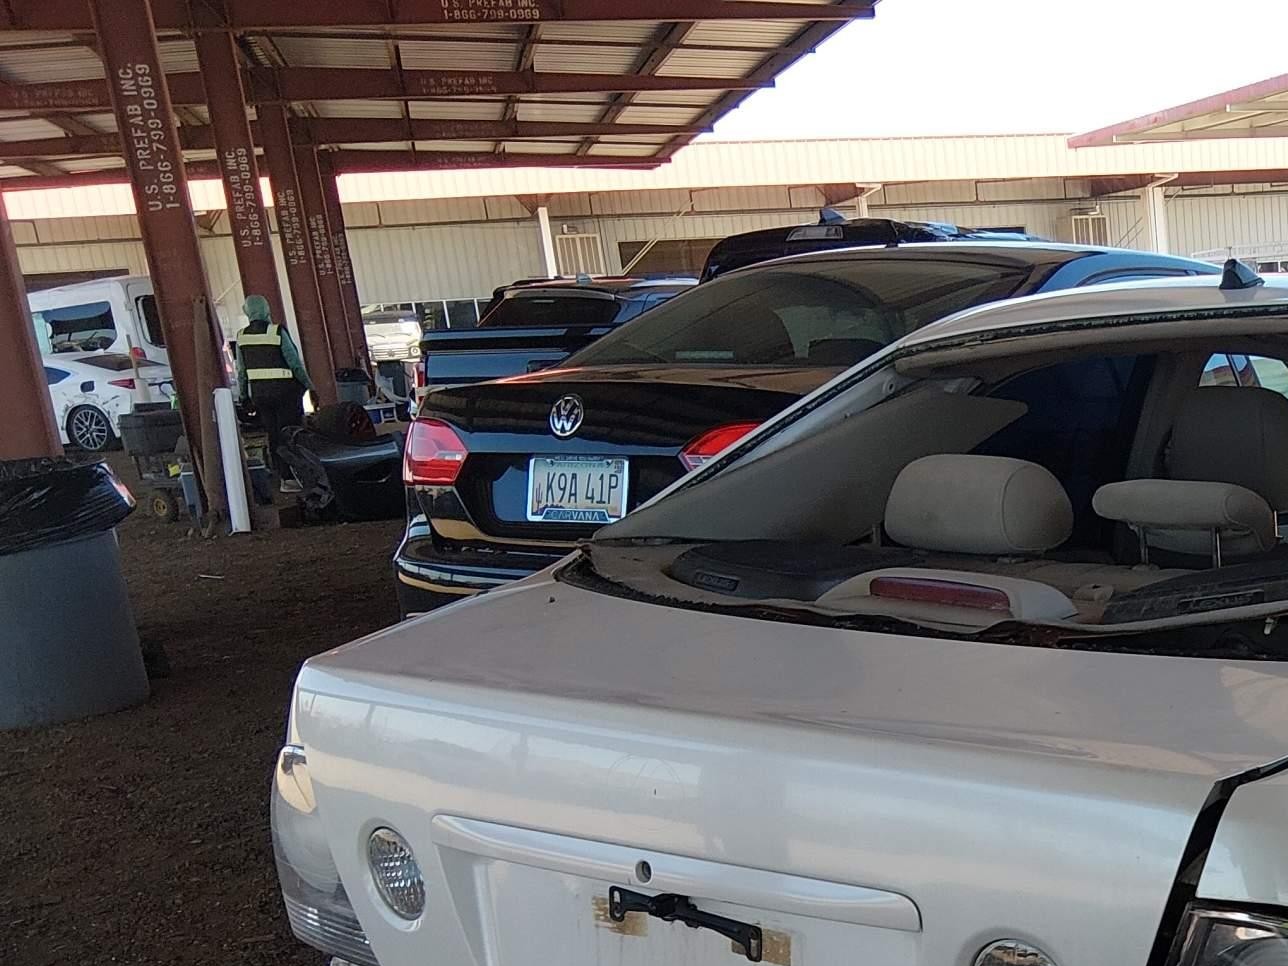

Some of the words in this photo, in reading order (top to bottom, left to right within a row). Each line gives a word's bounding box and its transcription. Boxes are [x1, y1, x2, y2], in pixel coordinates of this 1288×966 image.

[469, 0, 512, 8] PREFAB
[118, 63, 138, 96] INC.
[127, 104, 154, 170] PREFAB
[135, 64, 180, 210] 1-866-799-0969
[225, 148, 238, 170] INC.
[145, 179, 163, 212] U.S.
[230, 175, 247, 220] PREFAB
[236, 148, 263, 246] 1-866-799-0969
[240, 226, 252, 248] U.S.
[546, 472, 578, 504] K9A
[585, 472, 619, 505] 41P
[550, 511, 600, 521] CARVANA
